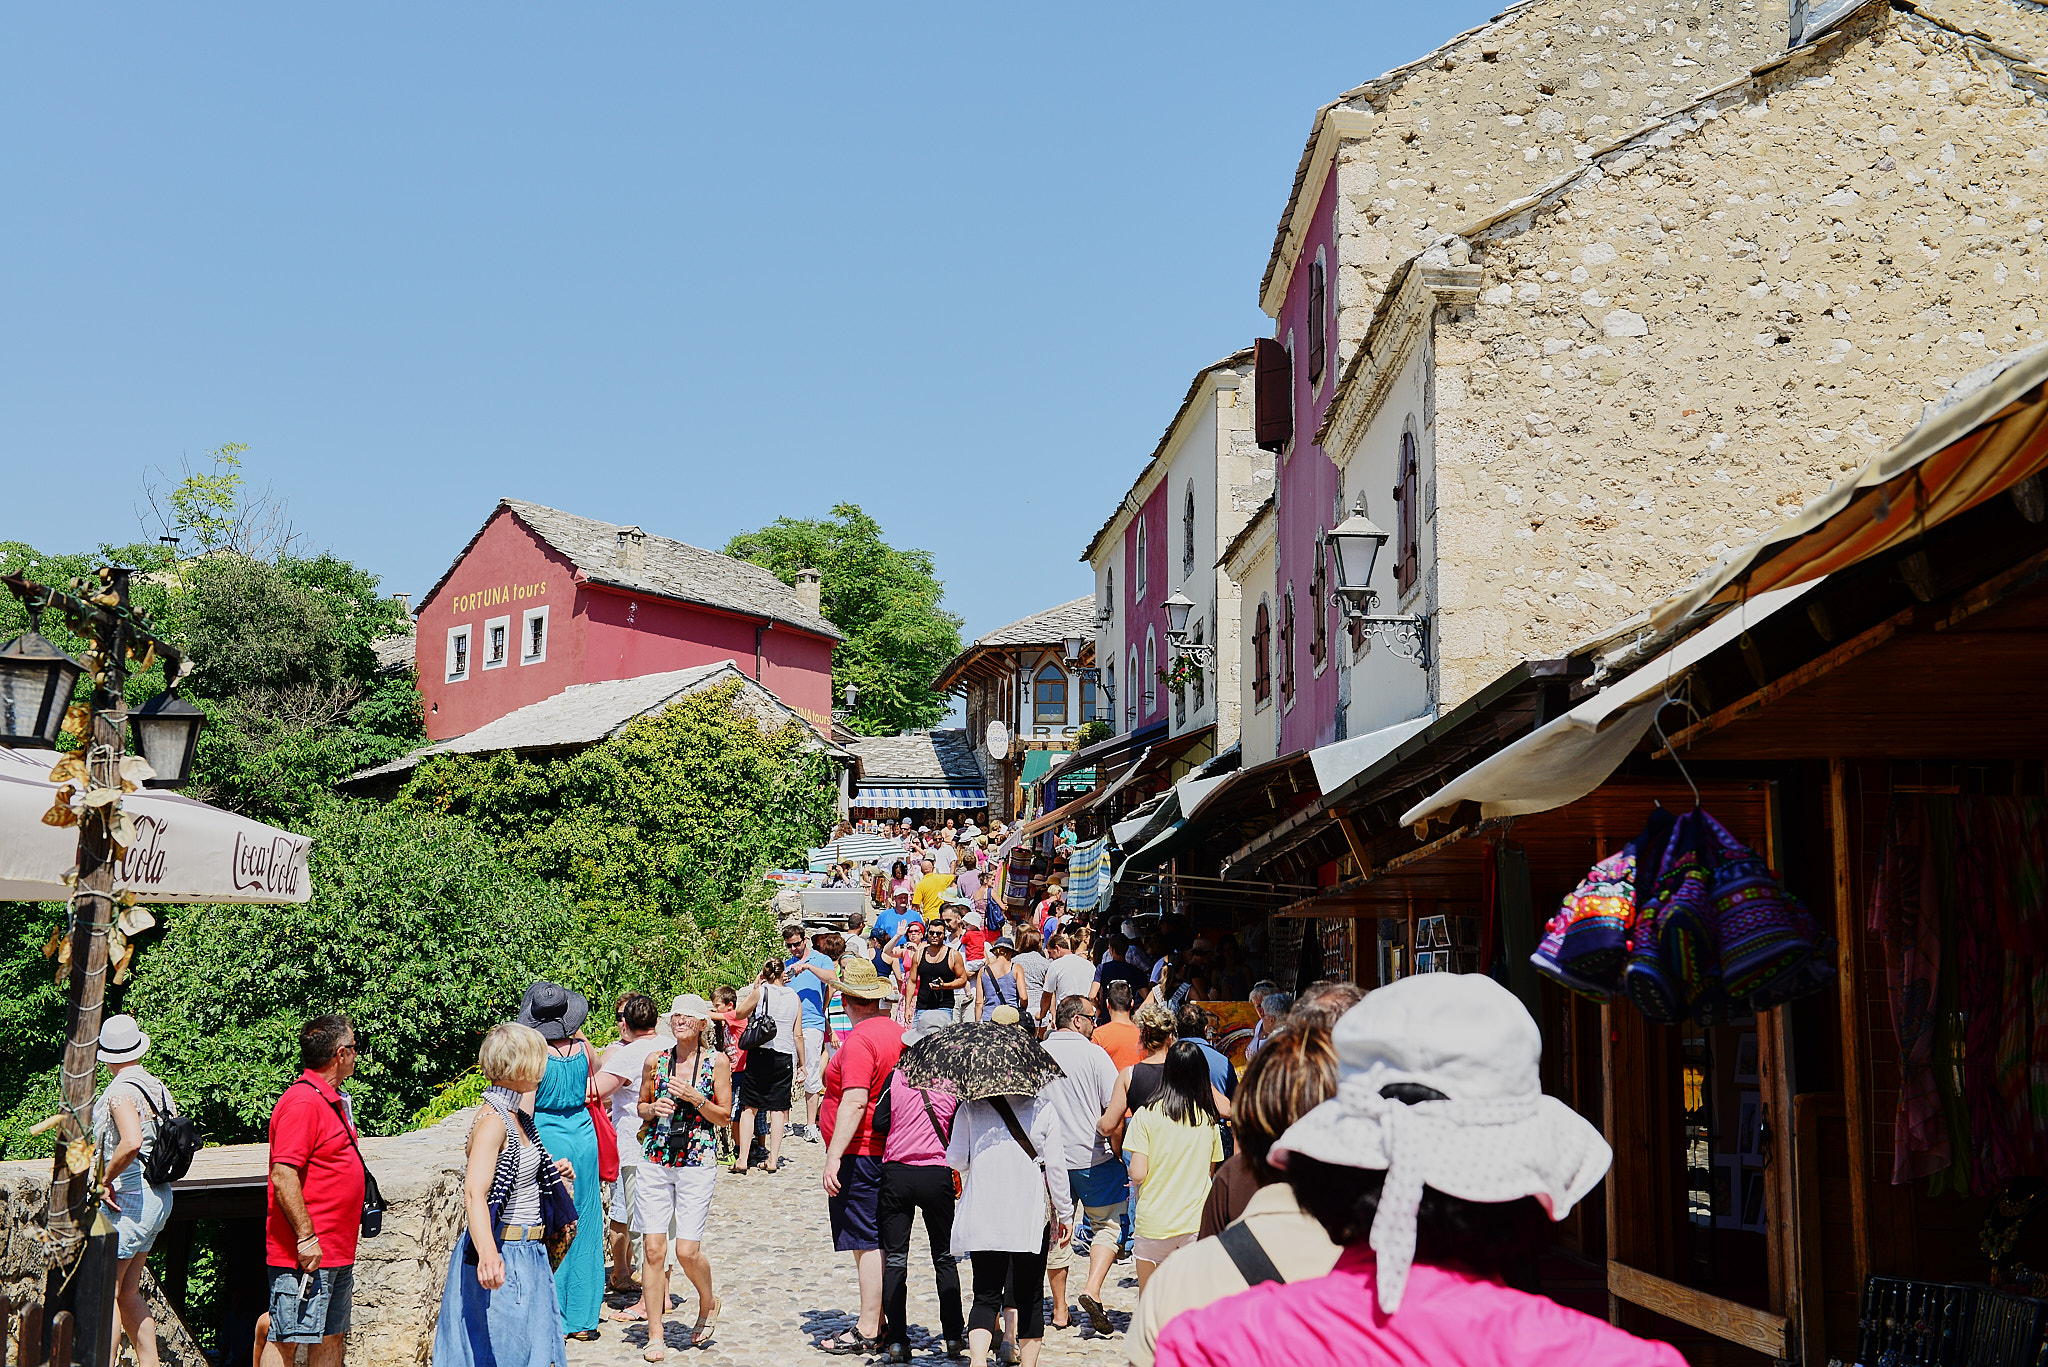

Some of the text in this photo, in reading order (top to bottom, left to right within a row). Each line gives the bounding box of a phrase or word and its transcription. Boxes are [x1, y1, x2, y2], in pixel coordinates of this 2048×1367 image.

[453, 581, 547, 615] FORTUNA tours
[812, 710, 831, 726] tours
